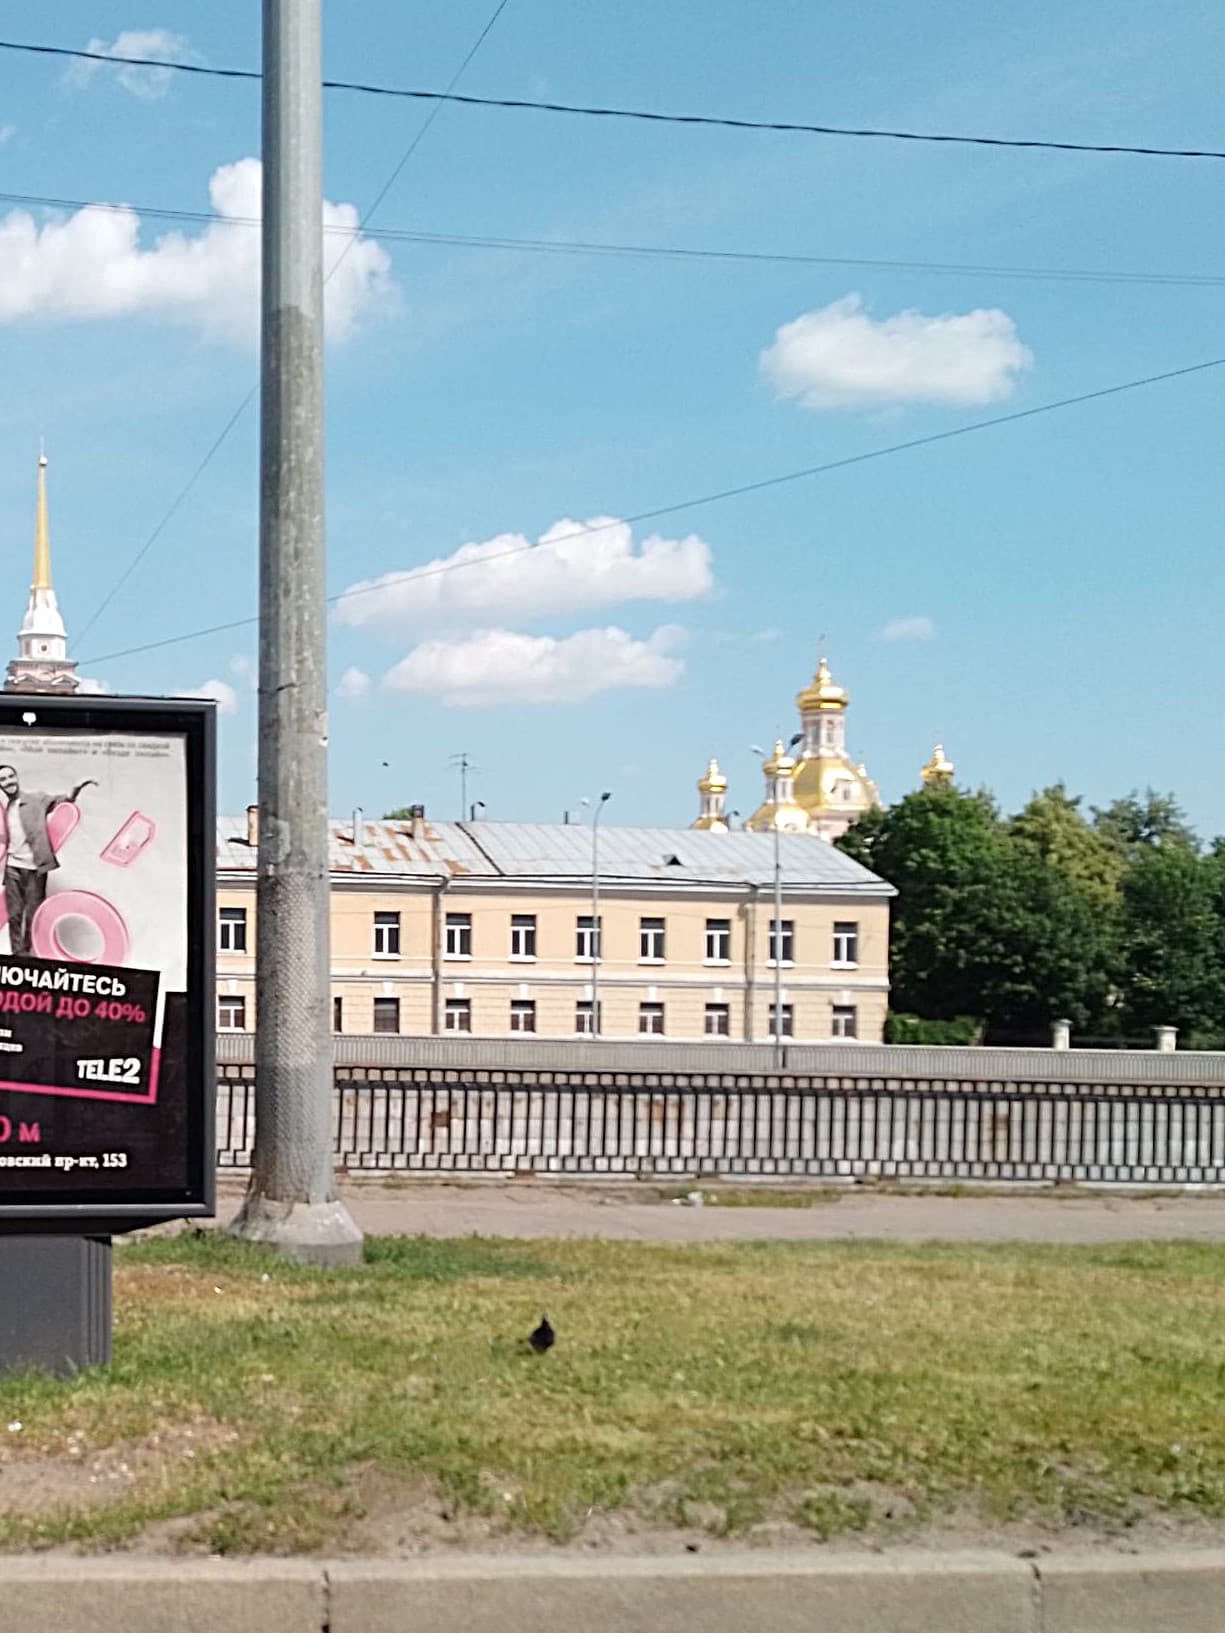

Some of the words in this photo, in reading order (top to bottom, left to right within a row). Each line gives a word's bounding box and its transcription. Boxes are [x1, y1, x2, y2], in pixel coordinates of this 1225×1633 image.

[55, 997, 91, 1020] ДО
[94, 1002, 146, 1023] 40%
[76, 1057, 142, 1085] TELE2
[102, 1153, 128, 1168] 153
